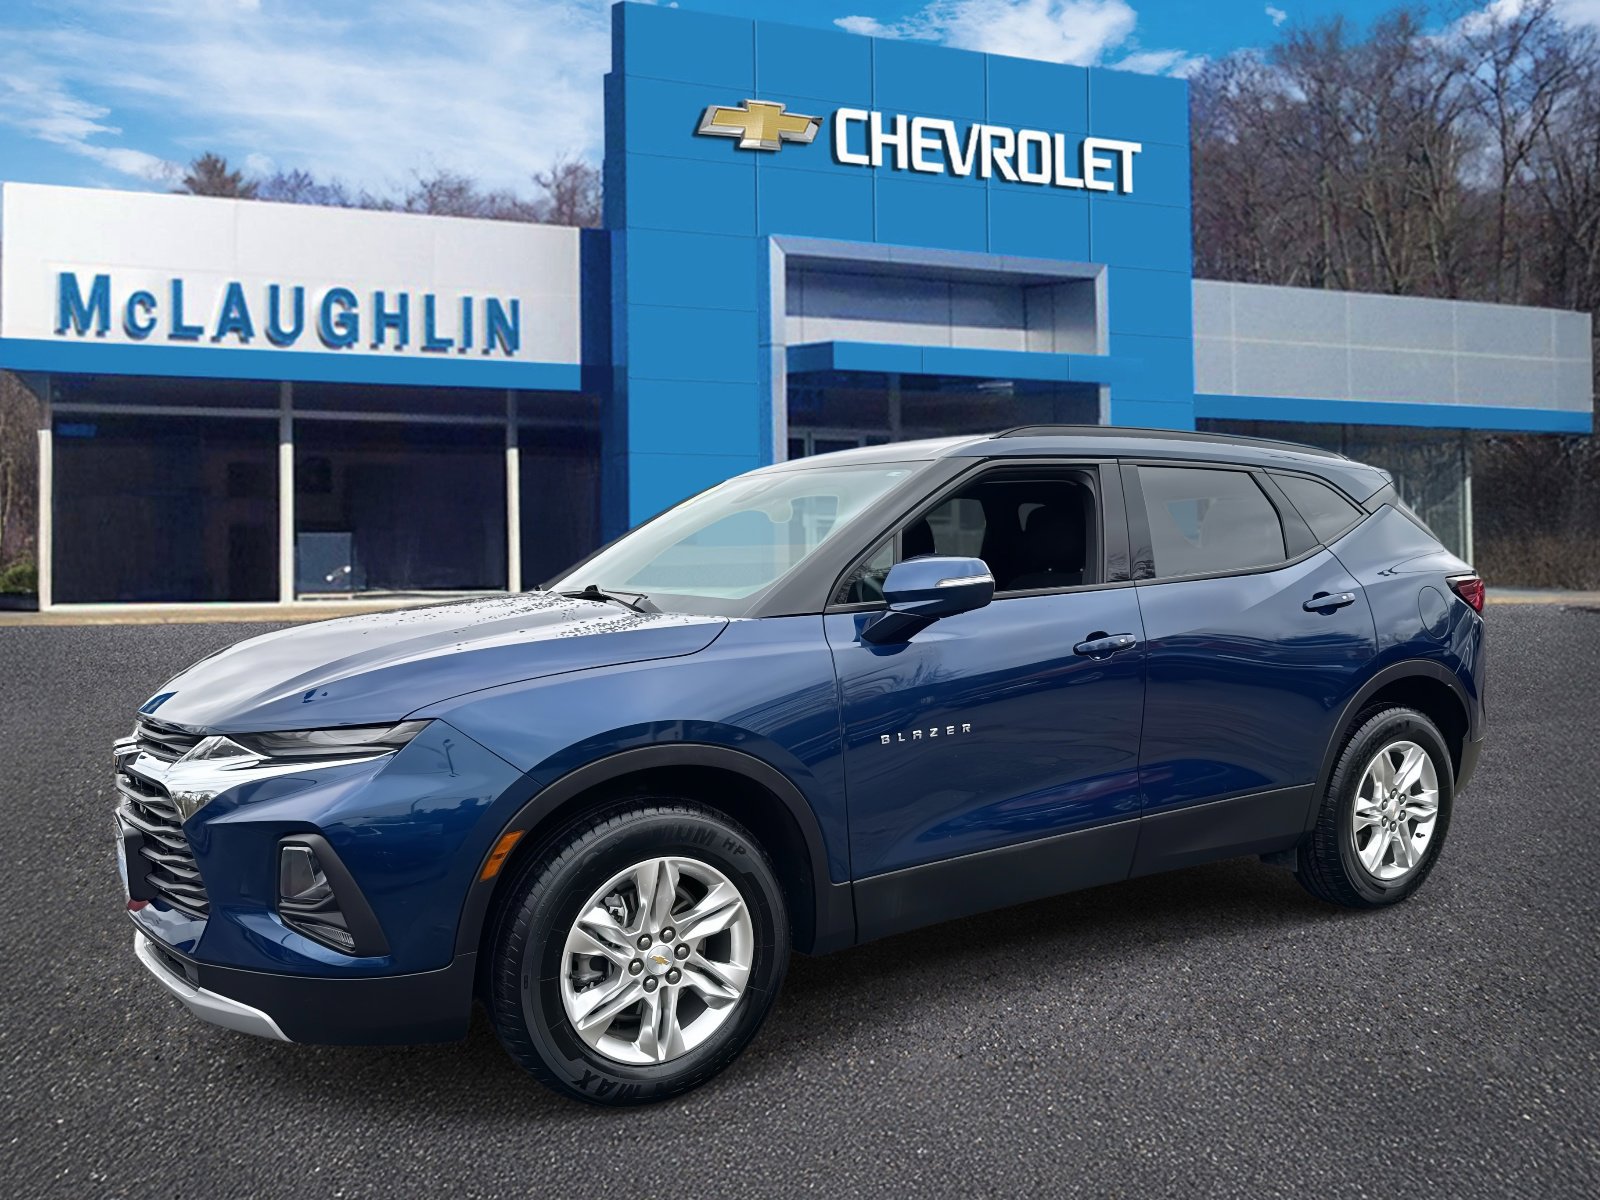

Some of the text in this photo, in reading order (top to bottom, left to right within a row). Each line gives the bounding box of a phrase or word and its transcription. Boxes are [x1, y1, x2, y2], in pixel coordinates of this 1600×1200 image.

[836, 107, 1142, 194] CHEVROLET
[55, 271, 520, 356] McLAUGHLIN
[880, 723, 971, 745] BLAZER
[722, 838, 747, 856] HP
